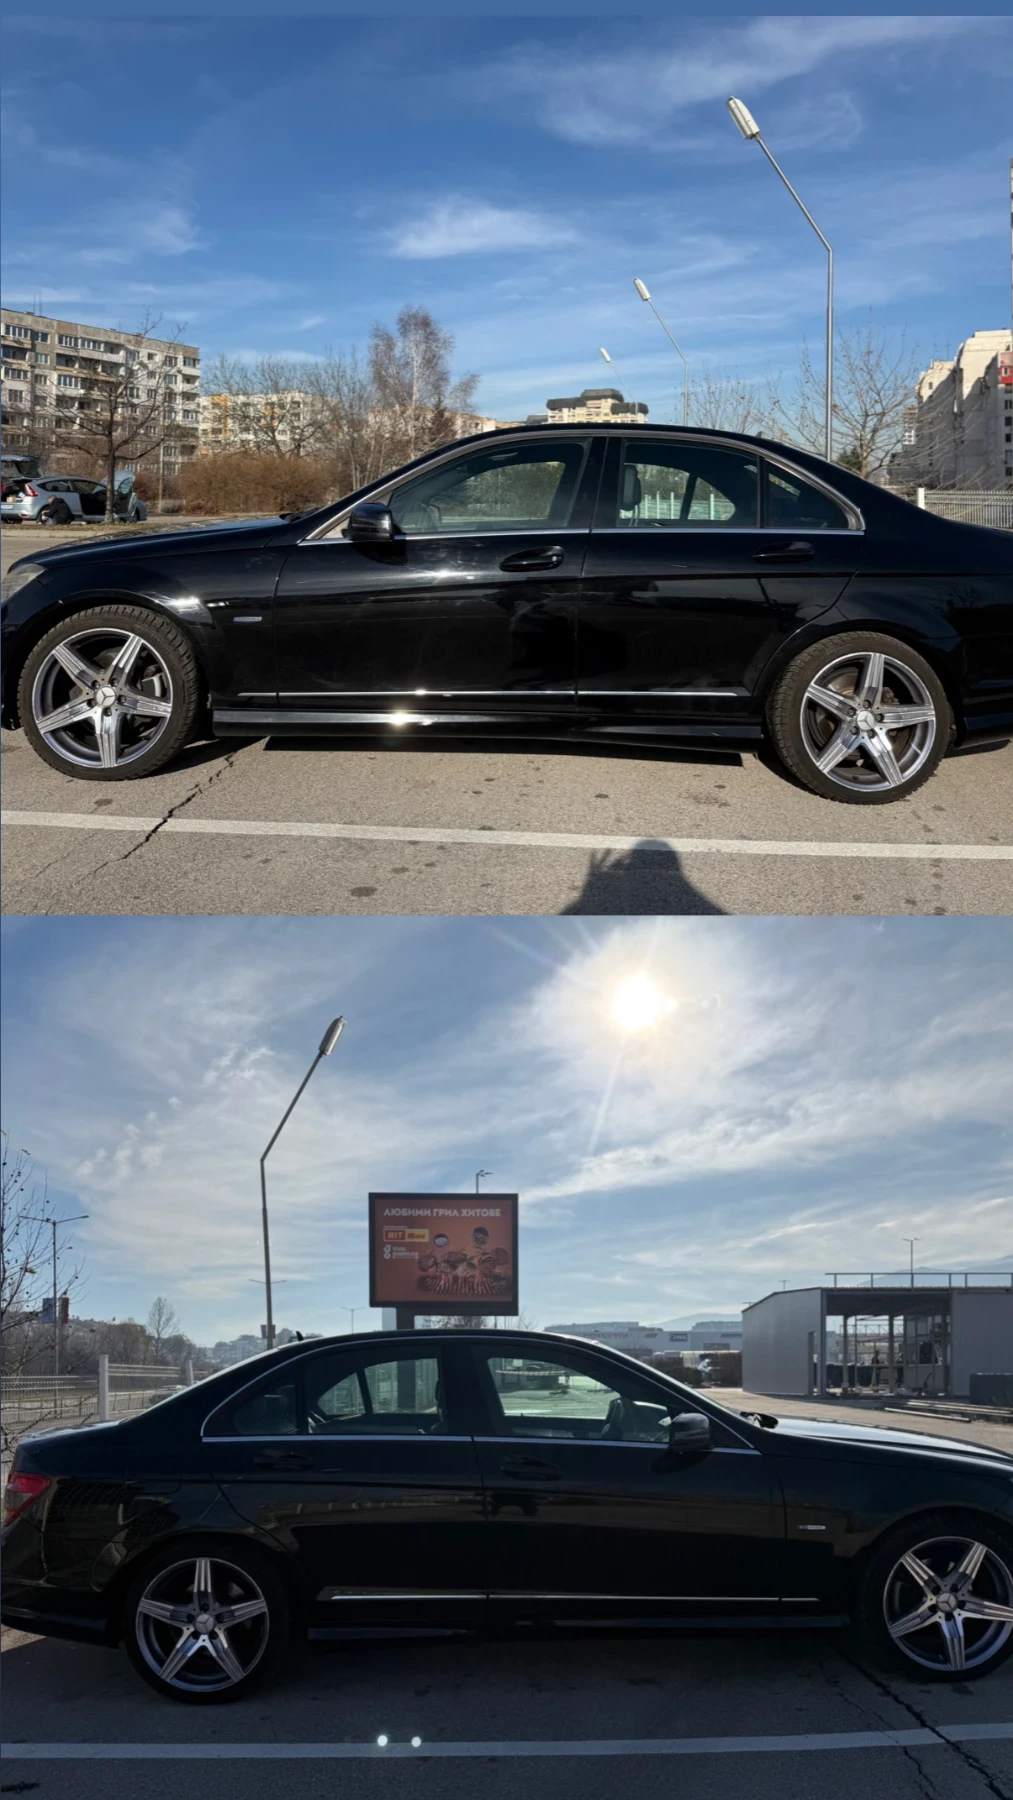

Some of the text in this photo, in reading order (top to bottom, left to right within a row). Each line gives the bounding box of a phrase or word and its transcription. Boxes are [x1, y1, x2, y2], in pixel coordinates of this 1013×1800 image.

[383, 1208, 502, 1217] ЛЮБИМИ ГРИЛ ХИТОВЕ
